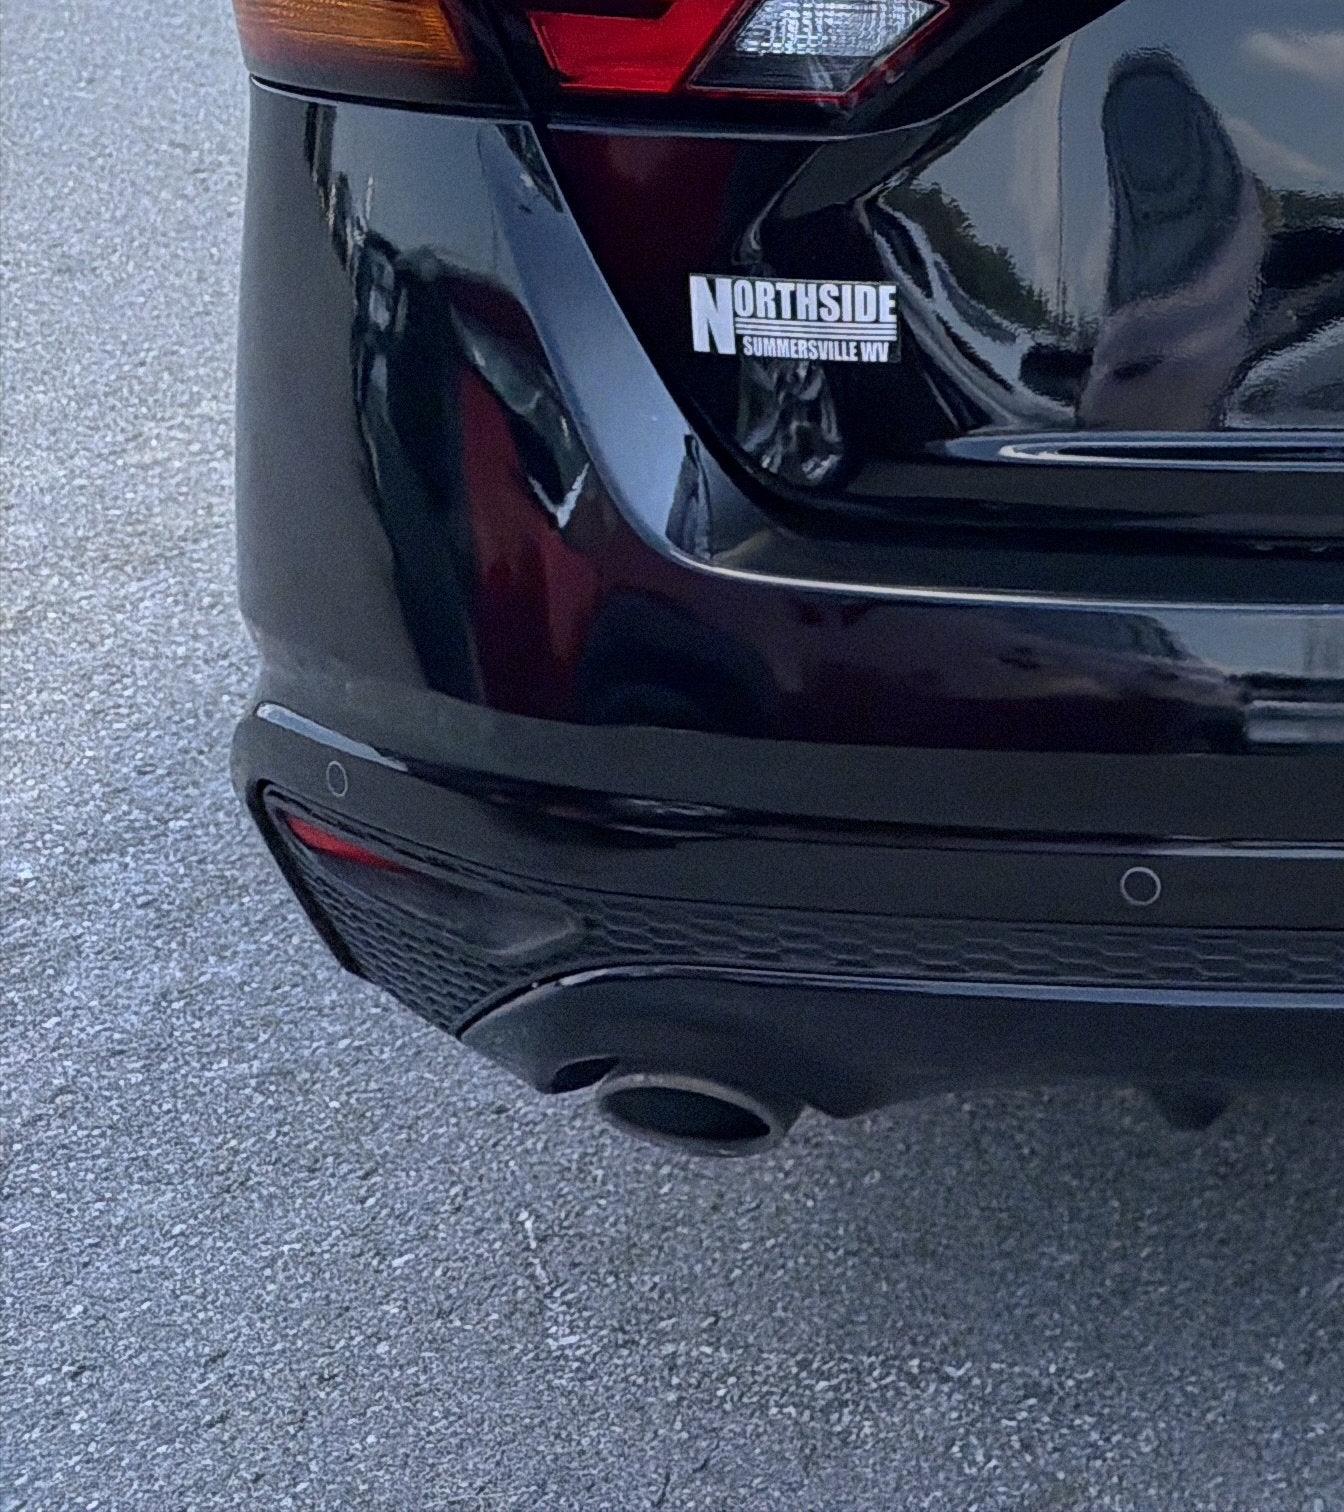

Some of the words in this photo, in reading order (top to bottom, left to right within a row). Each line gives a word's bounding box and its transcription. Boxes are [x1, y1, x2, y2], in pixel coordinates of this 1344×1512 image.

[690, 274, 897, 356] NORTHSIDE
[743, 335, 859, 362] SUMMERSVILLE
[859, 341, 889, 363] WV
